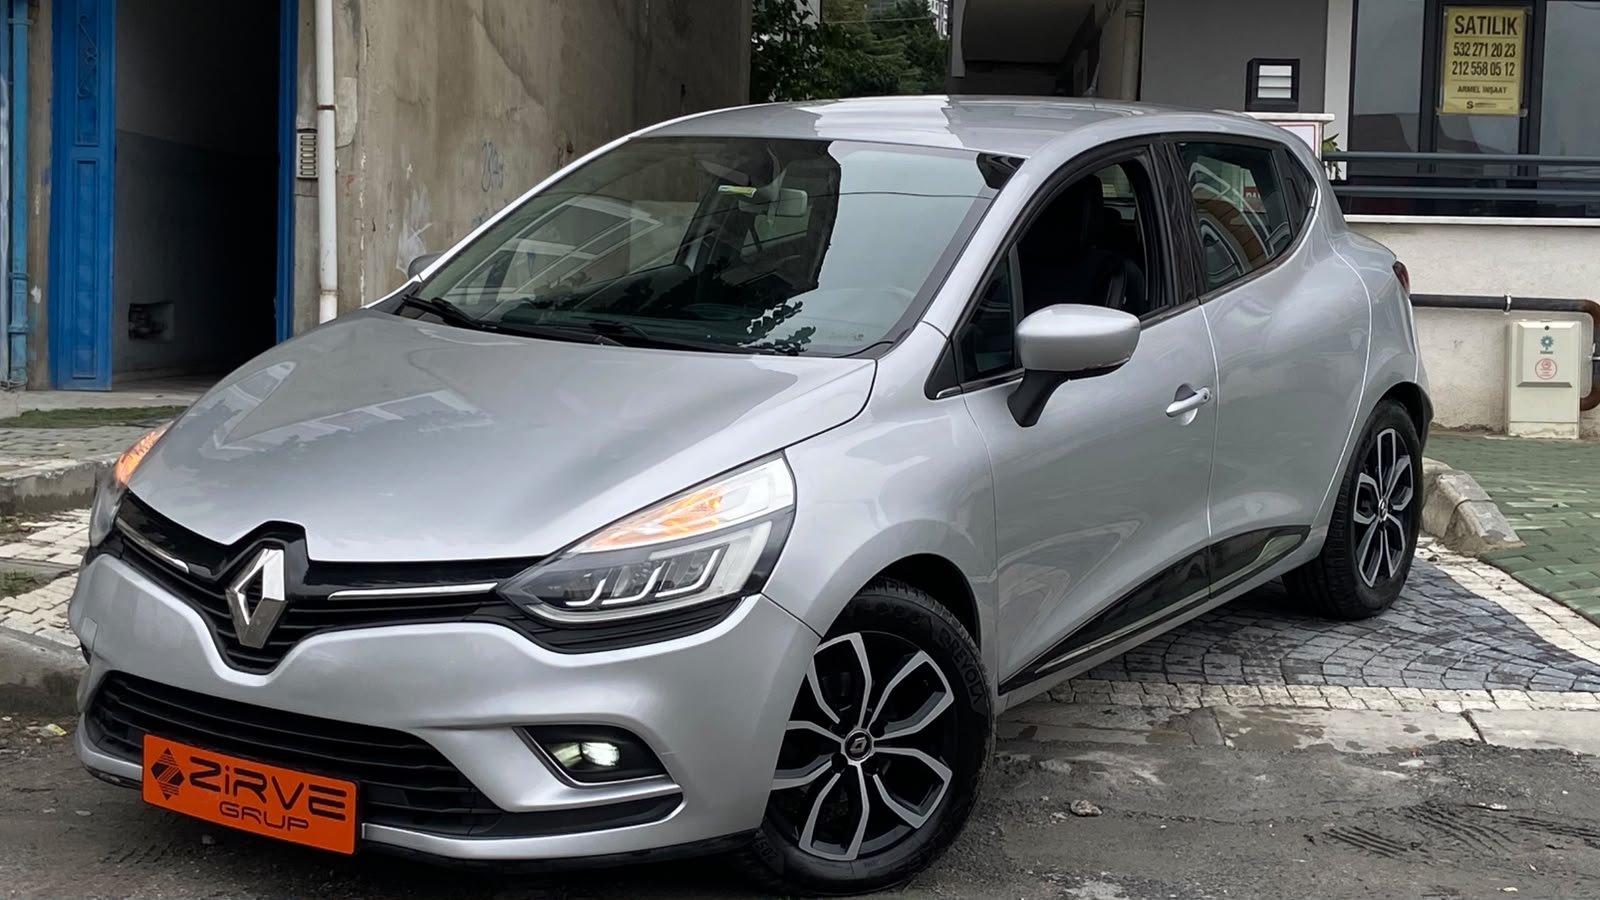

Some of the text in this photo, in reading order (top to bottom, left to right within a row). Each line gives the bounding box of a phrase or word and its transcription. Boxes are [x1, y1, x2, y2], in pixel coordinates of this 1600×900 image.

[1454, 15, 1518, 36] SATILIK
[1453, 42, 1516, 58] 532 271 20 23
[1451, 60, 1515, 76] 212 558 05 12
[219, 800, 310, 832] GRUP
